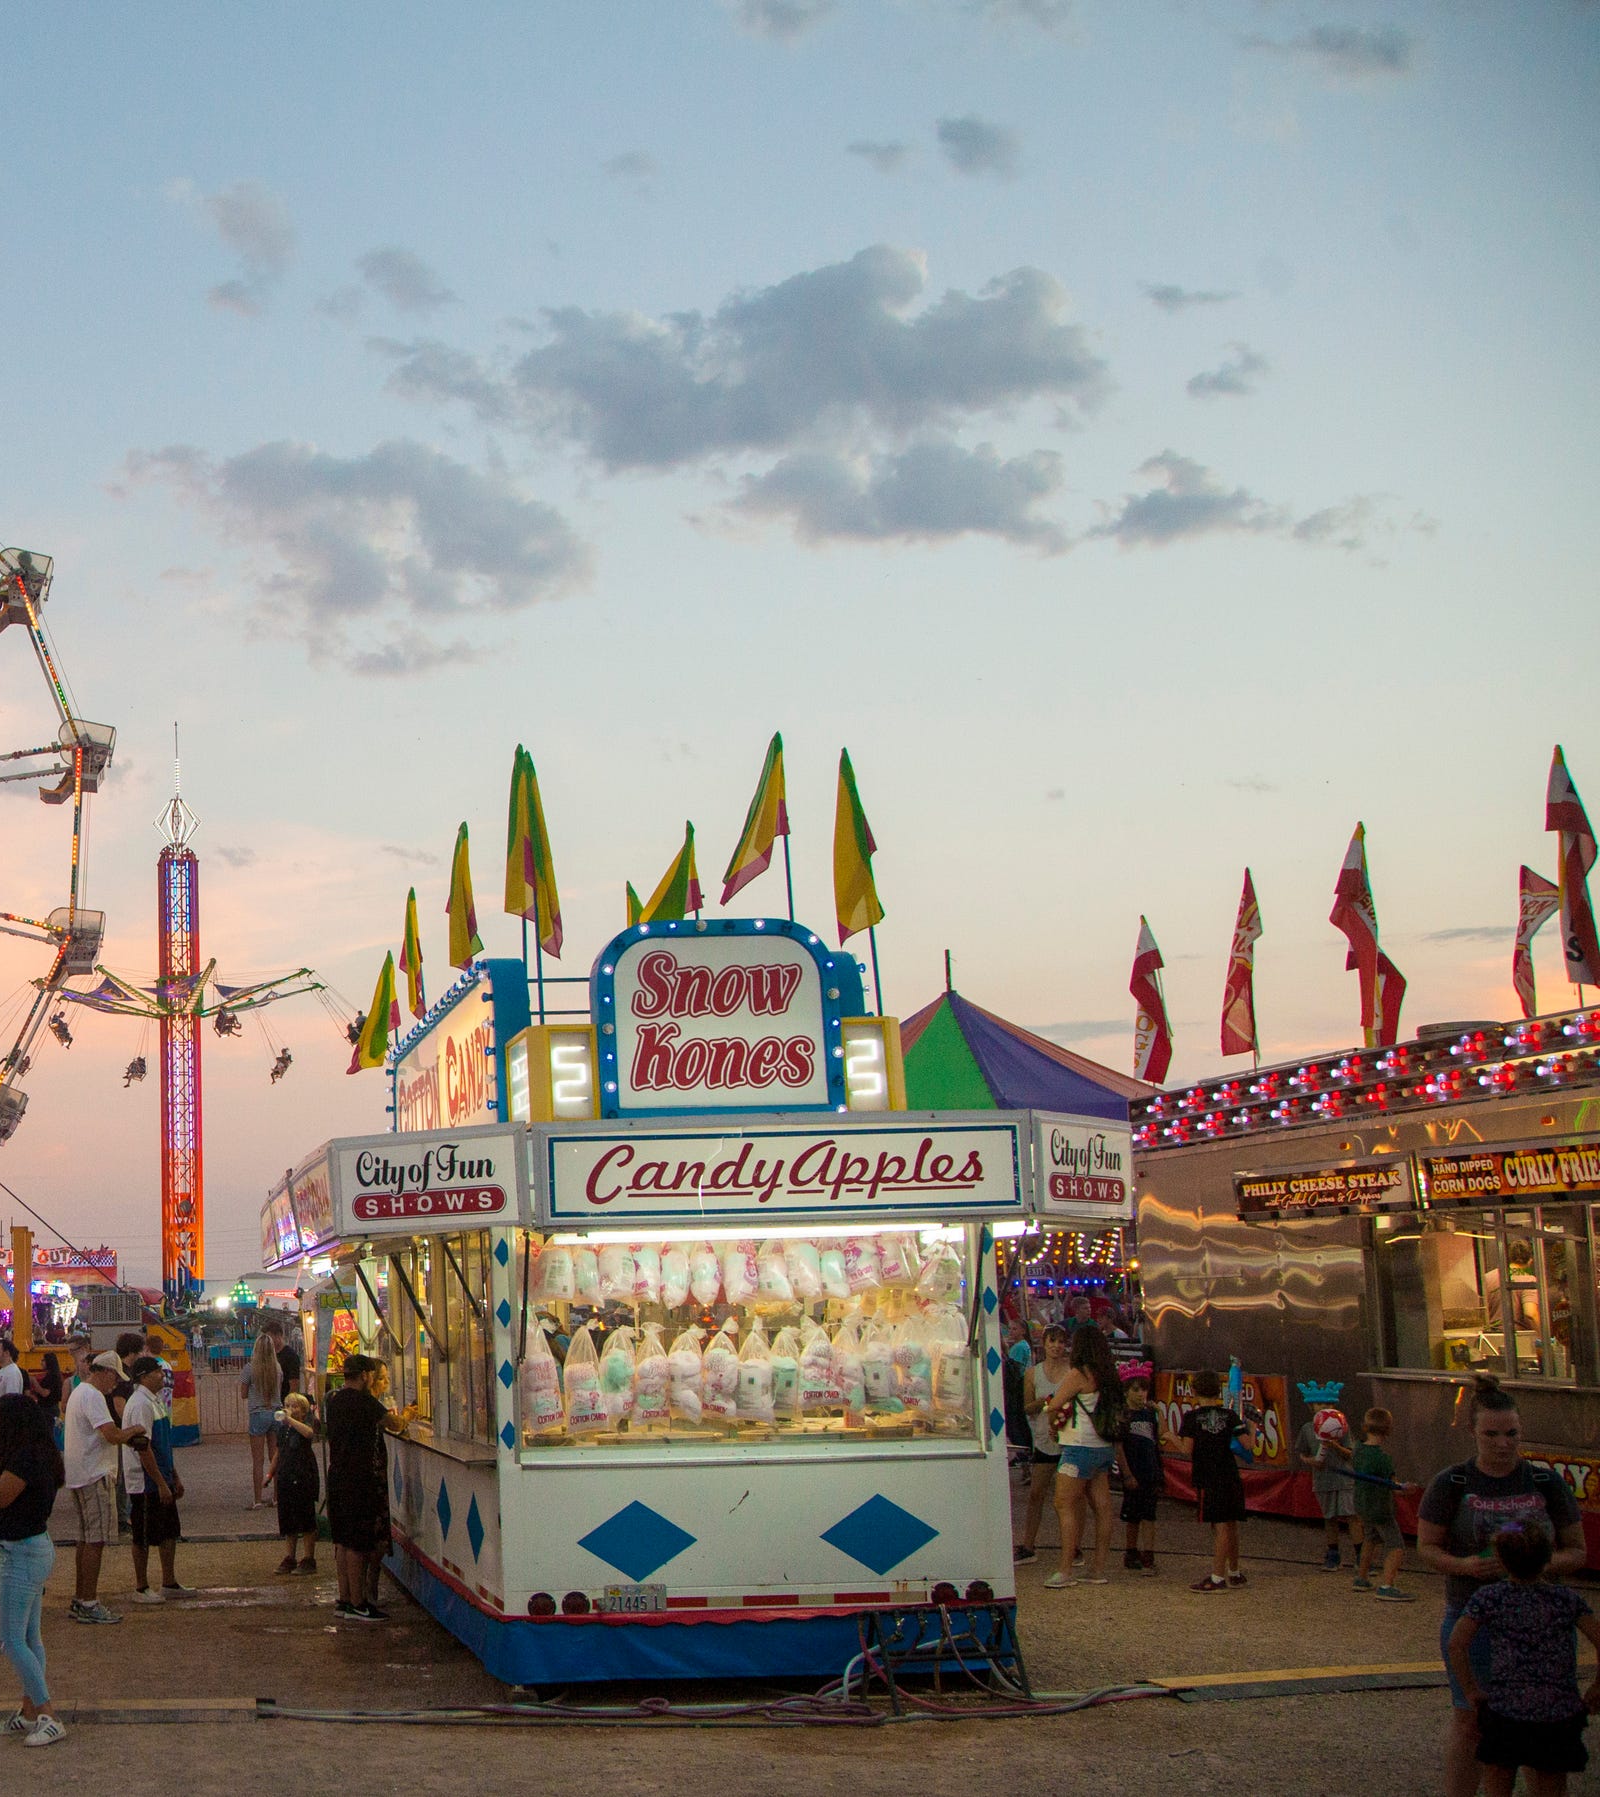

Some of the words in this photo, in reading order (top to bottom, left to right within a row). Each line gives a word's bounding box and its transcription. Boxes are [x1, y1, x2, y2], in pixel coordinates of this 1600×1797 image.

[631, 950, 802, 1019] Snow
[630, 1022, 816, 1091] Kones
[445, 1028, 491, 1127] CANDY
[1050, 1128, 1079, 1178] City
[1079, 1137, 1094, 1178] of
[1093, 1133, 1121, 1171] Fun
[355, 1151, 405, 1195] City
[408, 1150, 435, 1193] of
[436, 1144, 496, 1182] Fun
[585, 1142, 783, 1206] Candy
[786, 1137, 985, 1201] Apples
[1431, 1162, 1458, 1175] HAND
[1459, 1159, 1494, 1173] DIPPED
[1504, 1153, 1558, 1188] CURLY
[1558, 1150, 1600, 1183] FRIE
[1242, 1180, 1287, 1197] PHILLY
[1289, 1175, 1346, 1193] CHEESE
[1348, 1170, 1402, 1188] STEAK
[1433, 1179, 1465, 1194] CORN
[1467, 1174, 1501, 1191] DOGS
[1337, 1194, 1346, 1203] &
[38, 1249, 70, 1265] OUT
[1028, 1267, 1042, 1276] EXIT
[320, 1293, 351, 1308] ICE
[803, 1390, 823, 1400] COTTON
[1473, 1499, 1495, 1511] Old
[609, 1596, 648, 1611] 21445
